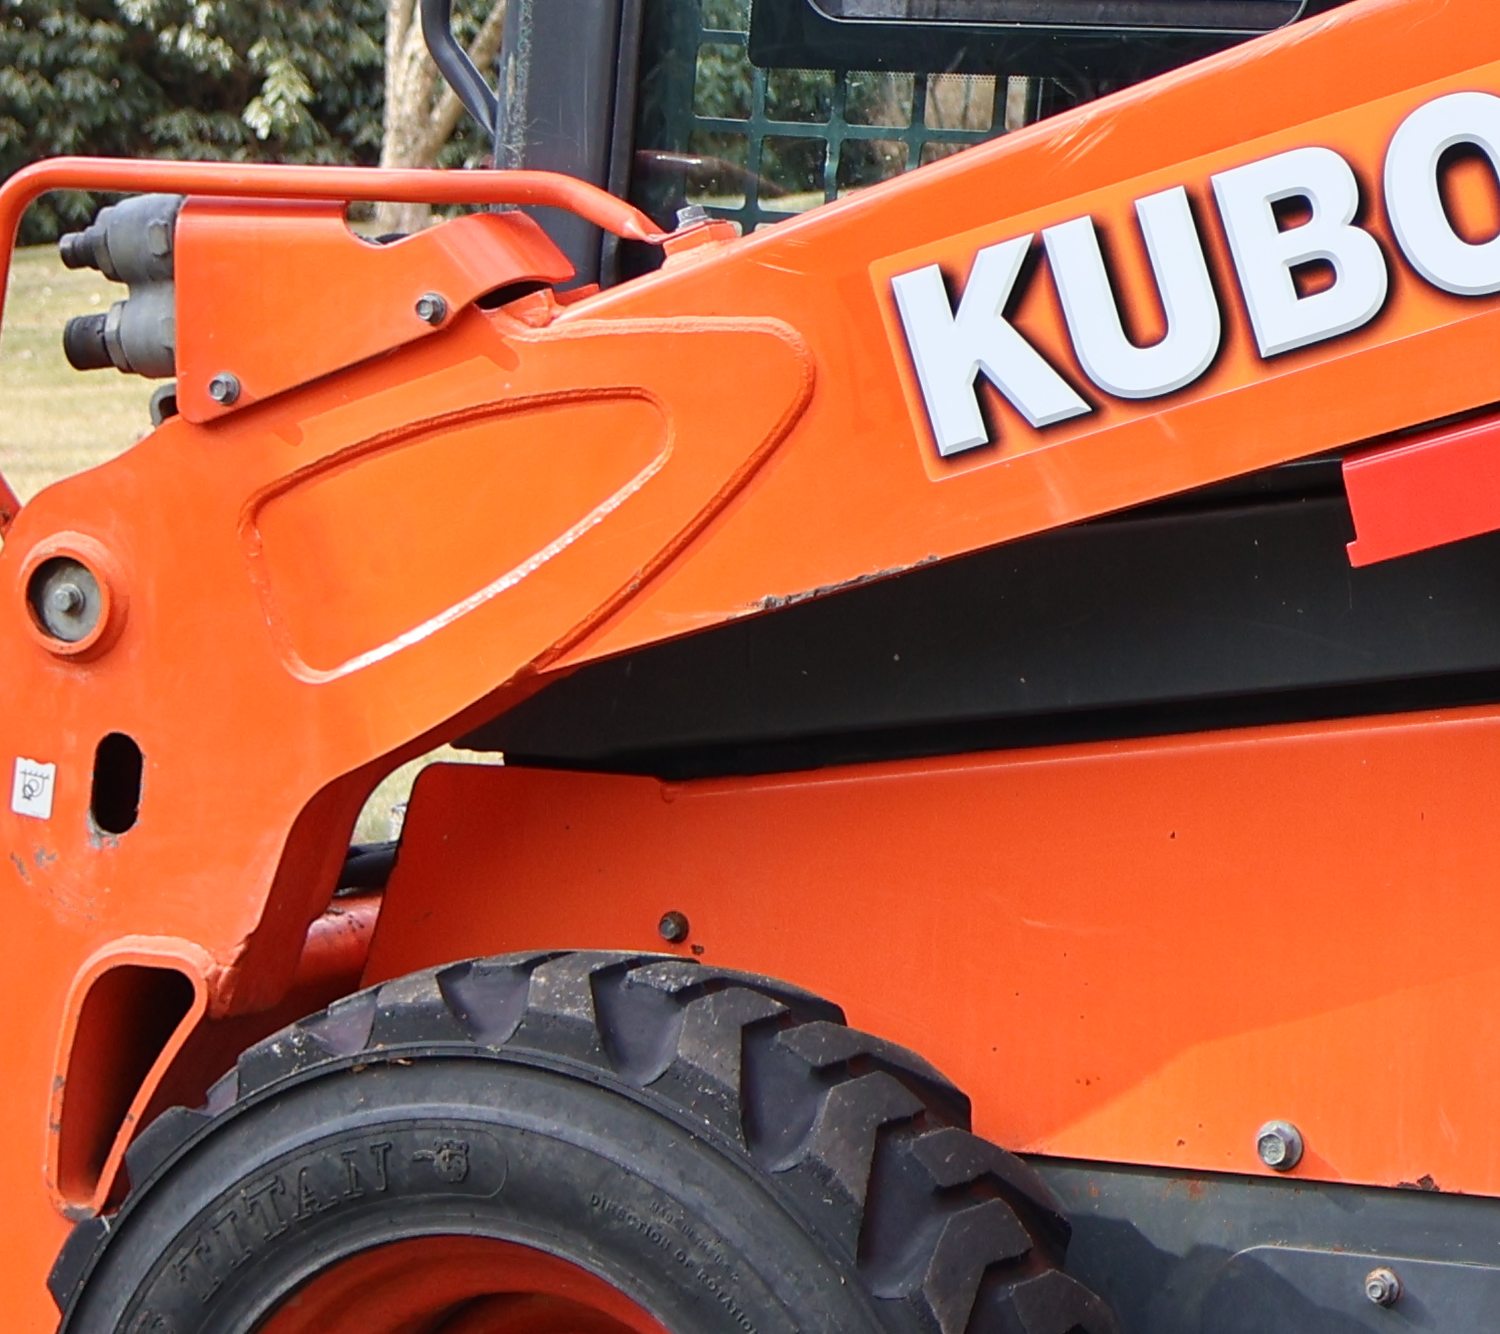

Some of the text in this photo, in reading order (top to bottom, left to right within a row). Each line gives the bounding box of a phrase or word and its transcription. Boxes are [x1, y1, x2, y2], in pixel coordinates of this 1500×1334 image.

[177, 1140, 393, 1304] TITAN
[590, 1194, 672, 1250] DIRECTION
[675, 1250, 696, 1269] OF
